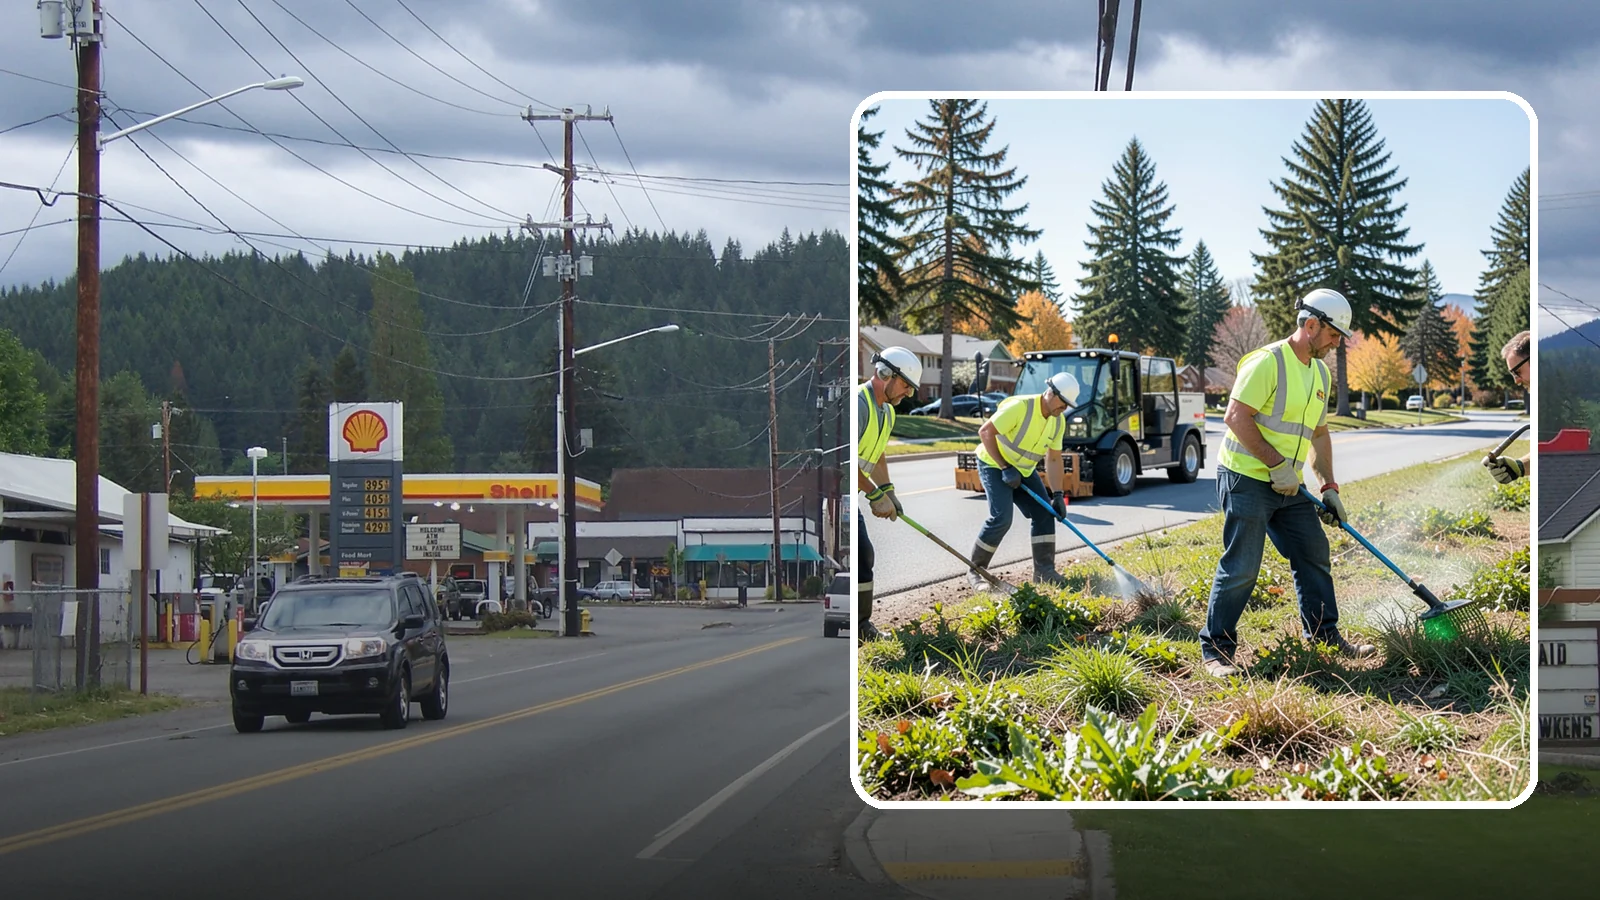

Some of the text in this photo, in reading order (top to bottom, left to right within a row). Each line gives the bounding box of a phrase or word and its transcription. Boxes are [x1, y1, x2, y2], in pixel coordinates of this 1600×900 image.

[366, 480, 383, 490] 395
[490, 484, 547, 499] Shell
[366, 494, 383, 504] 405
[366, 508, 383, 518] 415
[365, 522, 383, 532] 429
